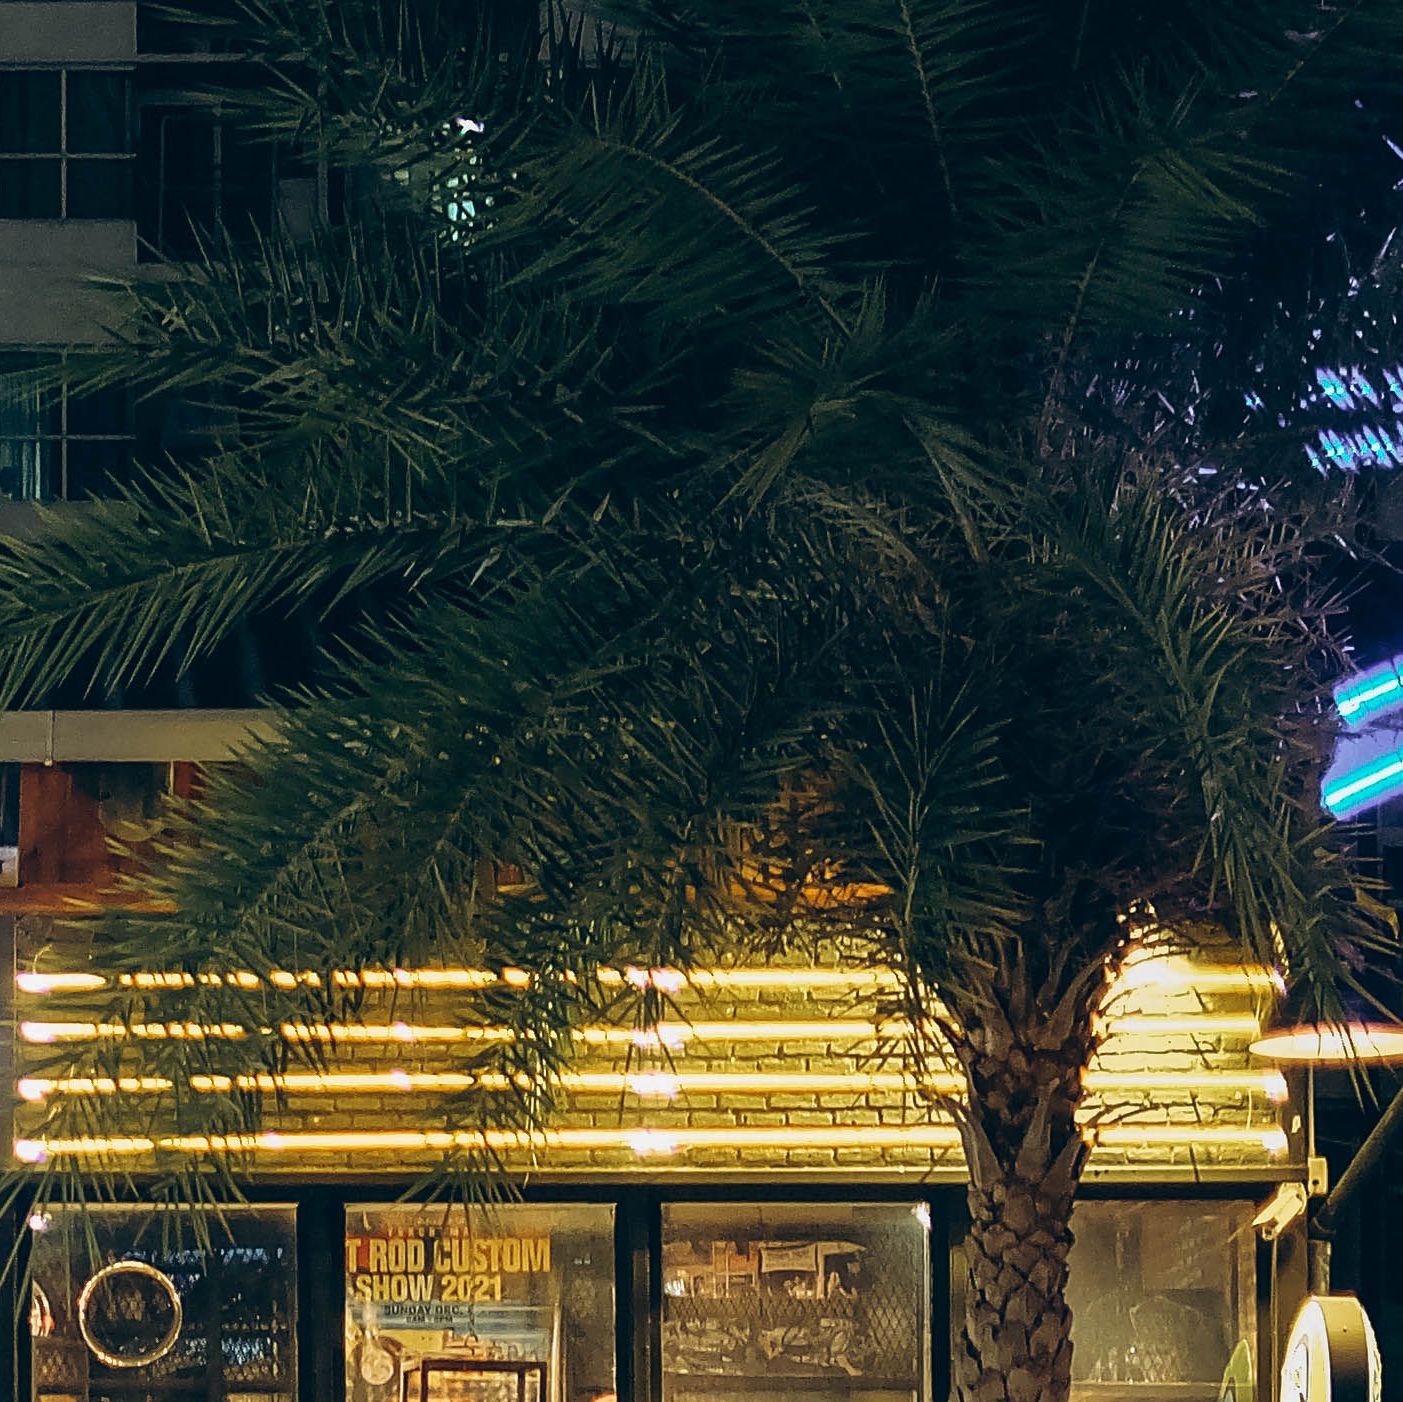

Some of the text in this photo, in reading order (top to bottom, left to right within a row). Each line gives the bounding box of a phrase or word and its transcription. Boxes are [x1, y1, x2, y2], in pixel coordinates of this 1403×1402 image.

[369, 1238, 425, 1273] ROD
[434, 1237, 551, 1273] CUSTOM
[356, 1273, 502, 1302] SHOW 2021
